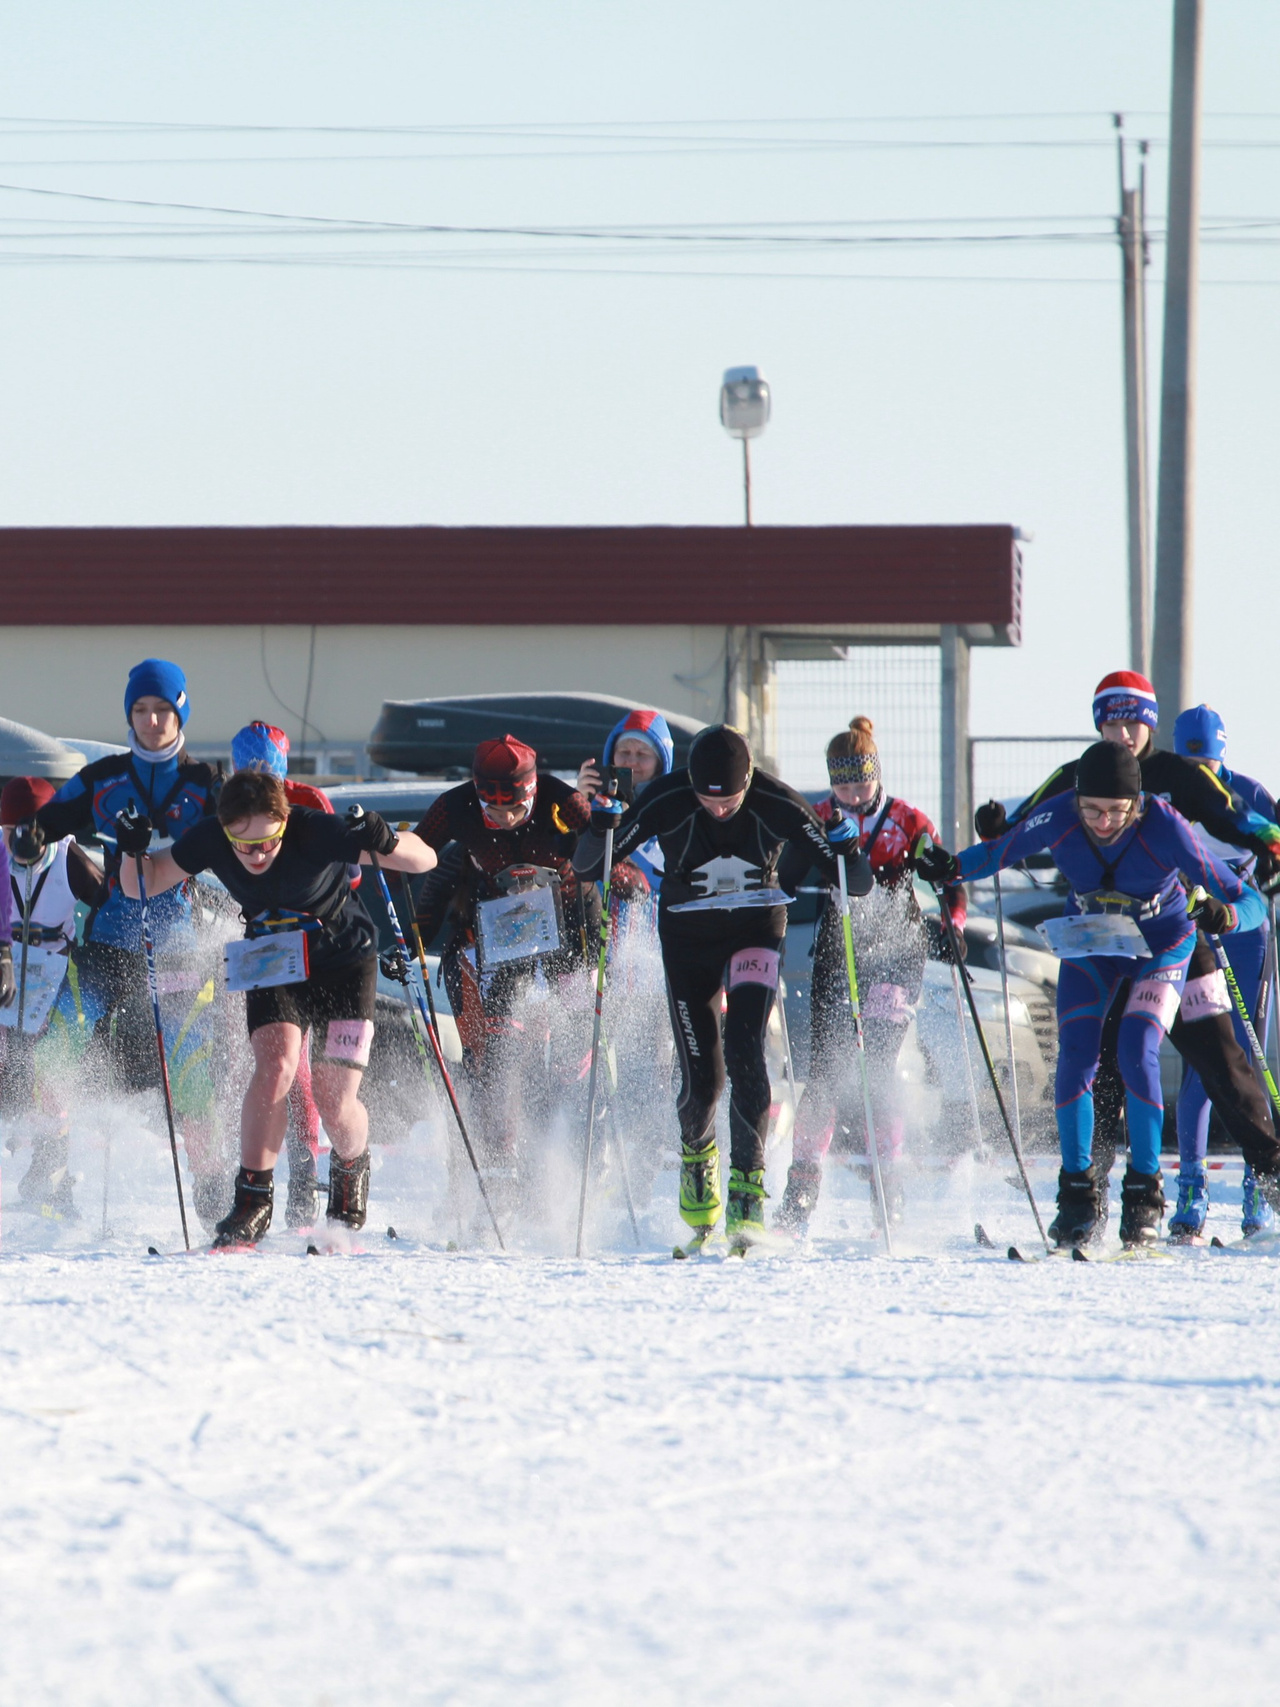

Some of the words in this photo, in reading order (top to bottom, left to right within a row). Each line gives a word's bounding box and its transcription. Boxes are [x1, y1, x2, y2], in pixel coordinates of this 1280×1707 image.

[736, 958, 770, 974] 405.1
[1224, 966, 1237, 986] SKI
[1231, 985, 1250, 1020] TEAM
[677, 999, 701, 1057] КУРГАН
